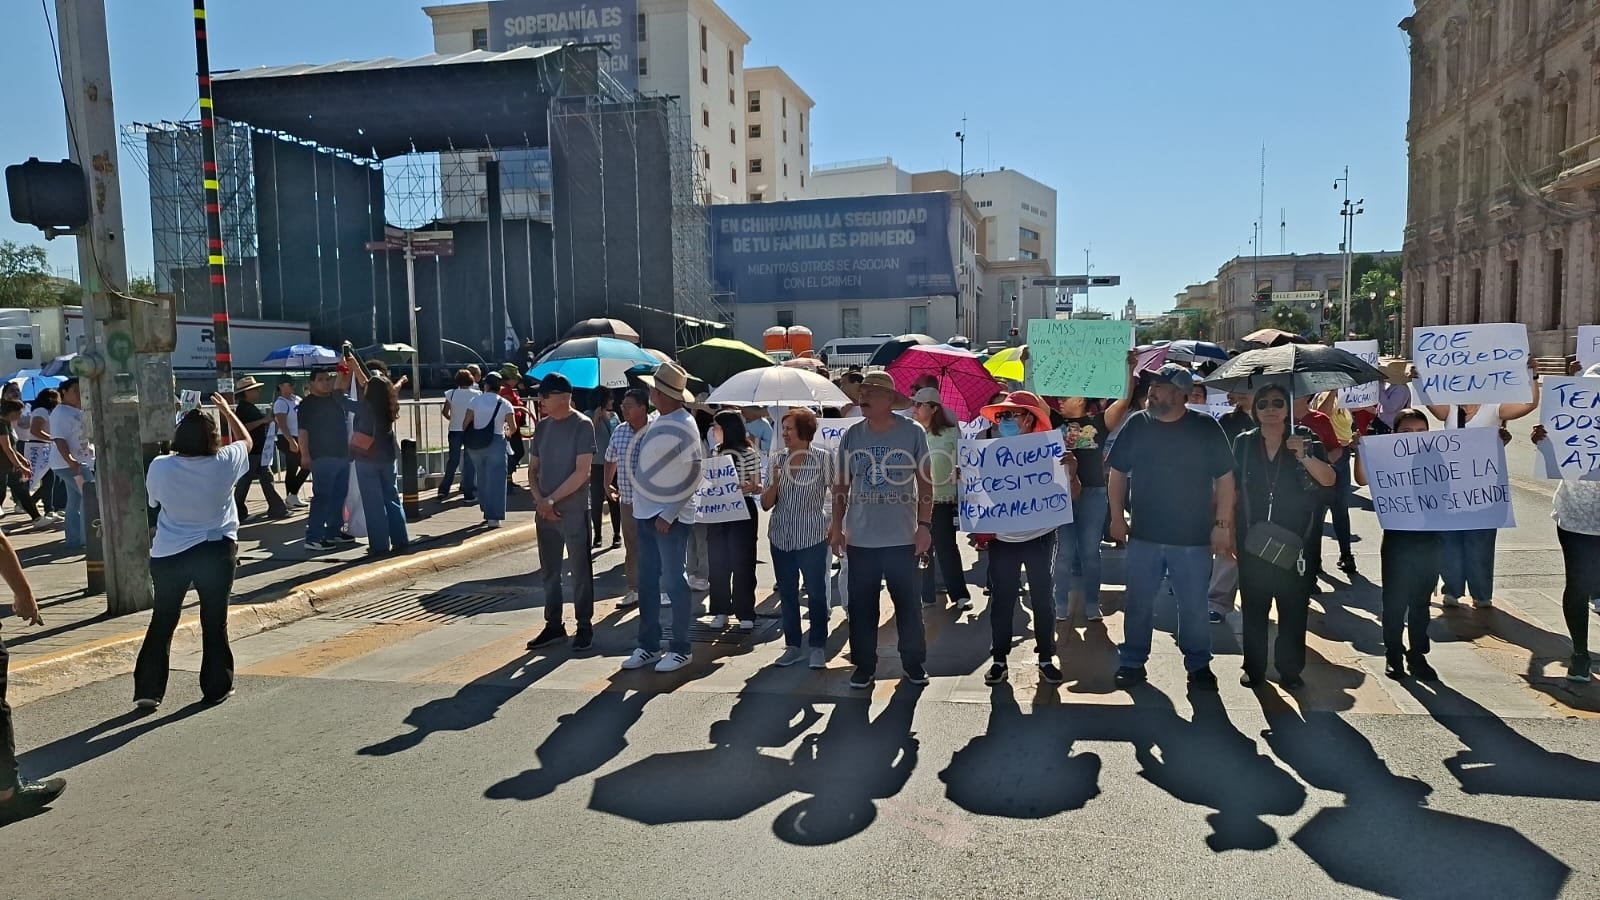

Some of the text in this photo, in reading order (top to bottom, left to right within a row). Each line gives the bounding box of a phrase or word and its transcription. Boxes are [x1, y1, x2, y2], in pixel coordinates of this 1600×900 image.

[504, 4, 622, 37] SOBERANÍA ES
[721, 208, 927, 233] EN CHIHUAHUA LA SEGURIDAD
[733, 229, 915, 253] DE TU FAMILIA ES PRIMERO
[748, 257, 900, 275] MIENTRAS OTROS SE ASOCIAN
[783, 274, 862, 289] CON EL CRIMEN
[1047, 321, 1077, 336] IMSS
[1032, 338, 1052, 346] VIDA
[1417, 331, 1473, 352] ZOE
[1422, 370, 1521, 393] MIENTE
[960, 442, 1064, 468] SOY PACIENTE
[1393, 434, 1462, 458] OLIVOS
[965, 471, 1053, 495] NECESITO
[1376, 458, 1499, 489] ENTIENDE LA
[695, 482, 737, 497] ECESITO
[1376, 484, 1511, 514] BASE NO SE VENDE
[960, 493, 1068, 520] MEDICAMENTOS
